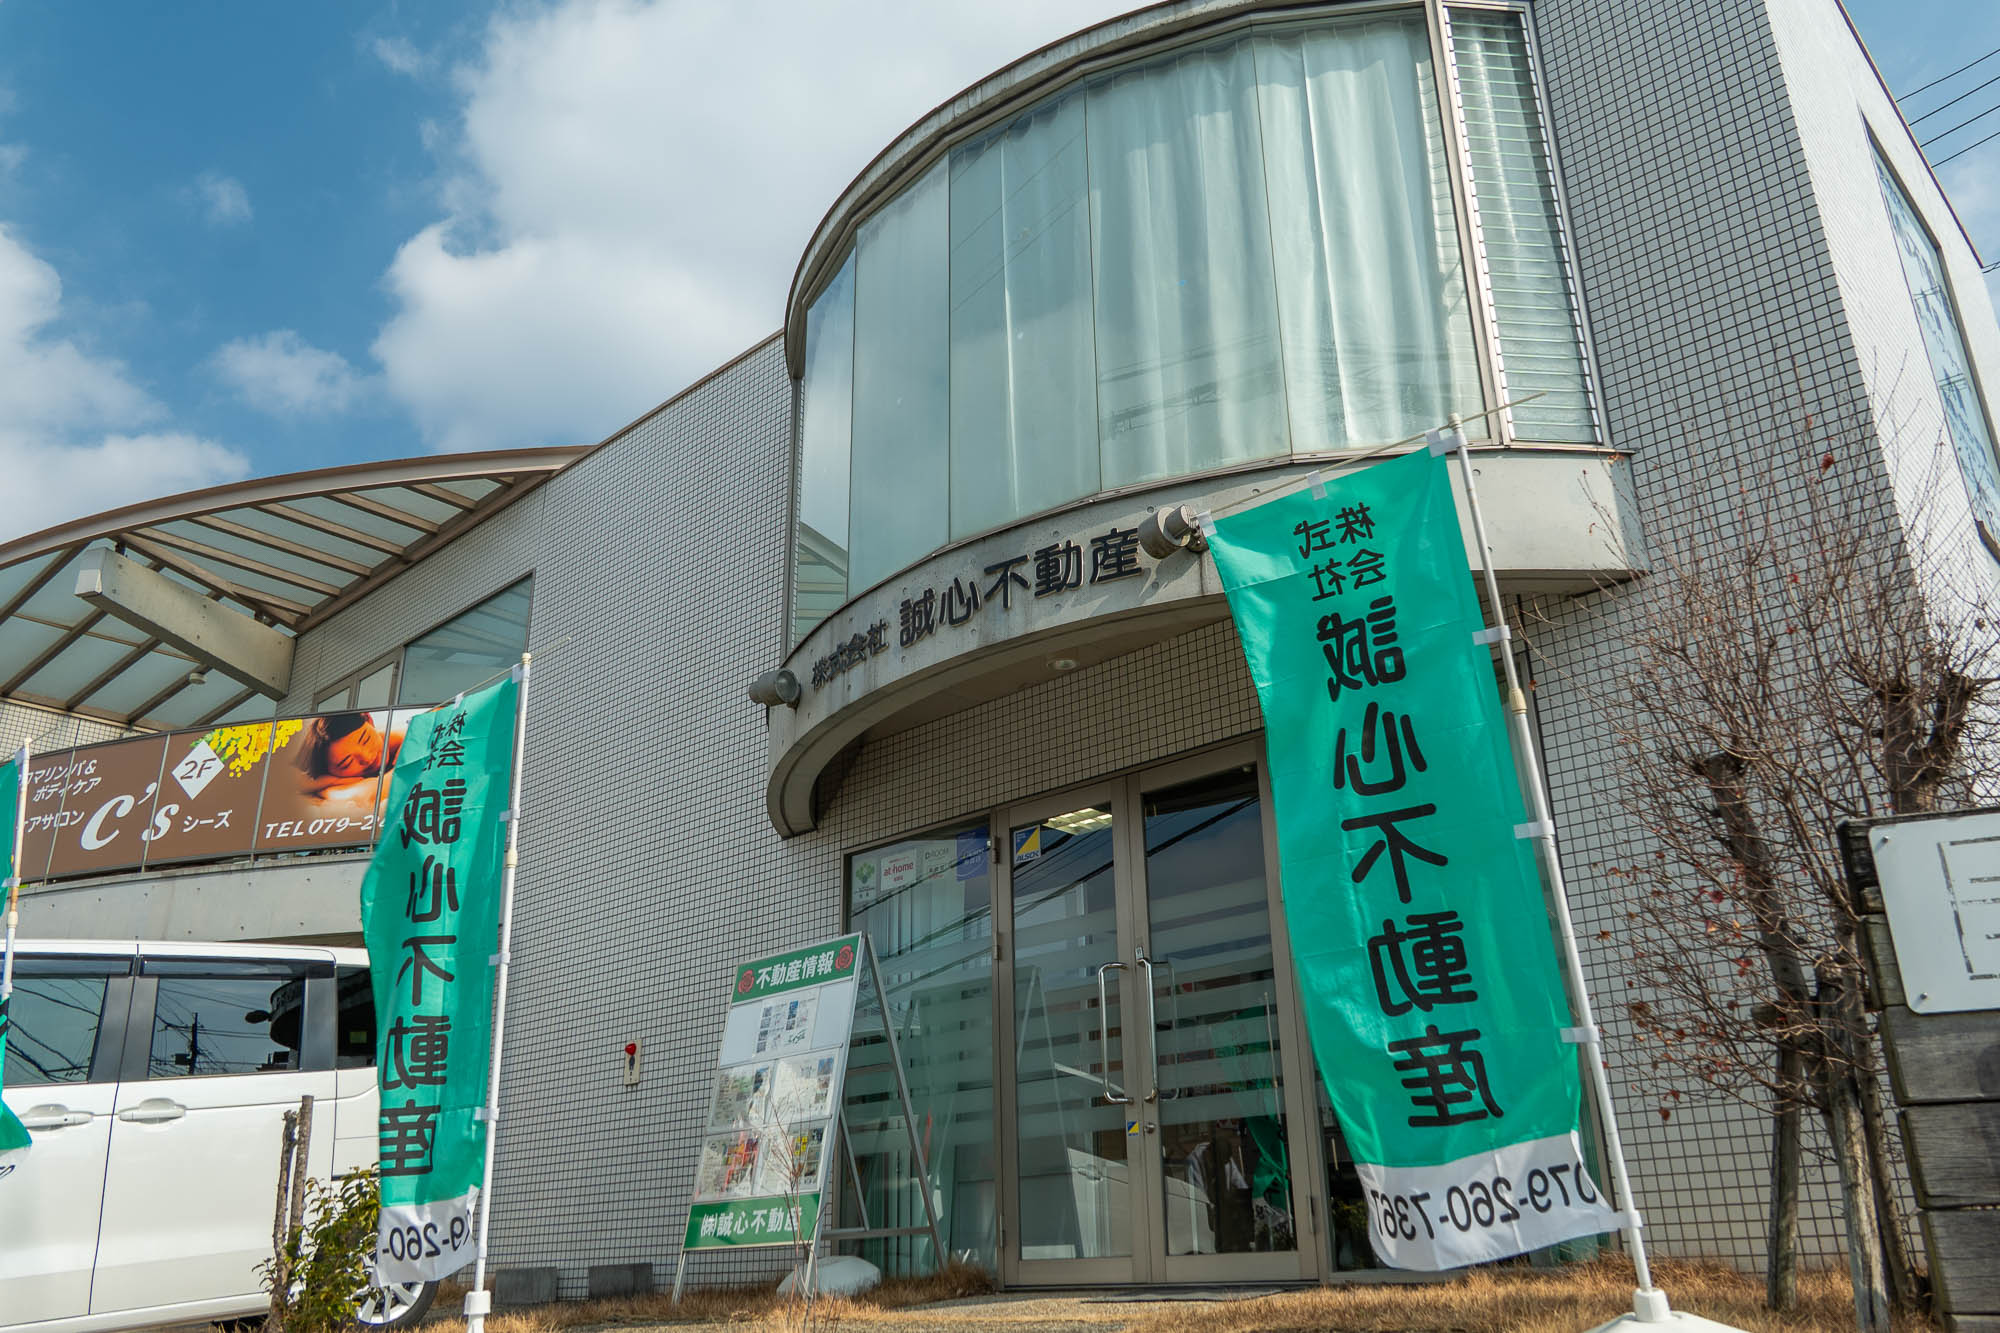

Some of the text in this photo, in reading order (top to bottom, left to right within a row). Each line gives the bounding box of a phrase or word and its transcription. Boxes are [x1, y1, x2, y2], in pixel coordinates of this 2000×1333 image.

[810, 528, 1144, 690] 株式会社 誠心不動産
[180, 758, 217, 780] 2F
[81, 782, 180, 851] C's
[183, 809, 233, 833] シーズ
[265, 820, 304, 839] TEL
[756, 950, 835, 990] 不動産情報
